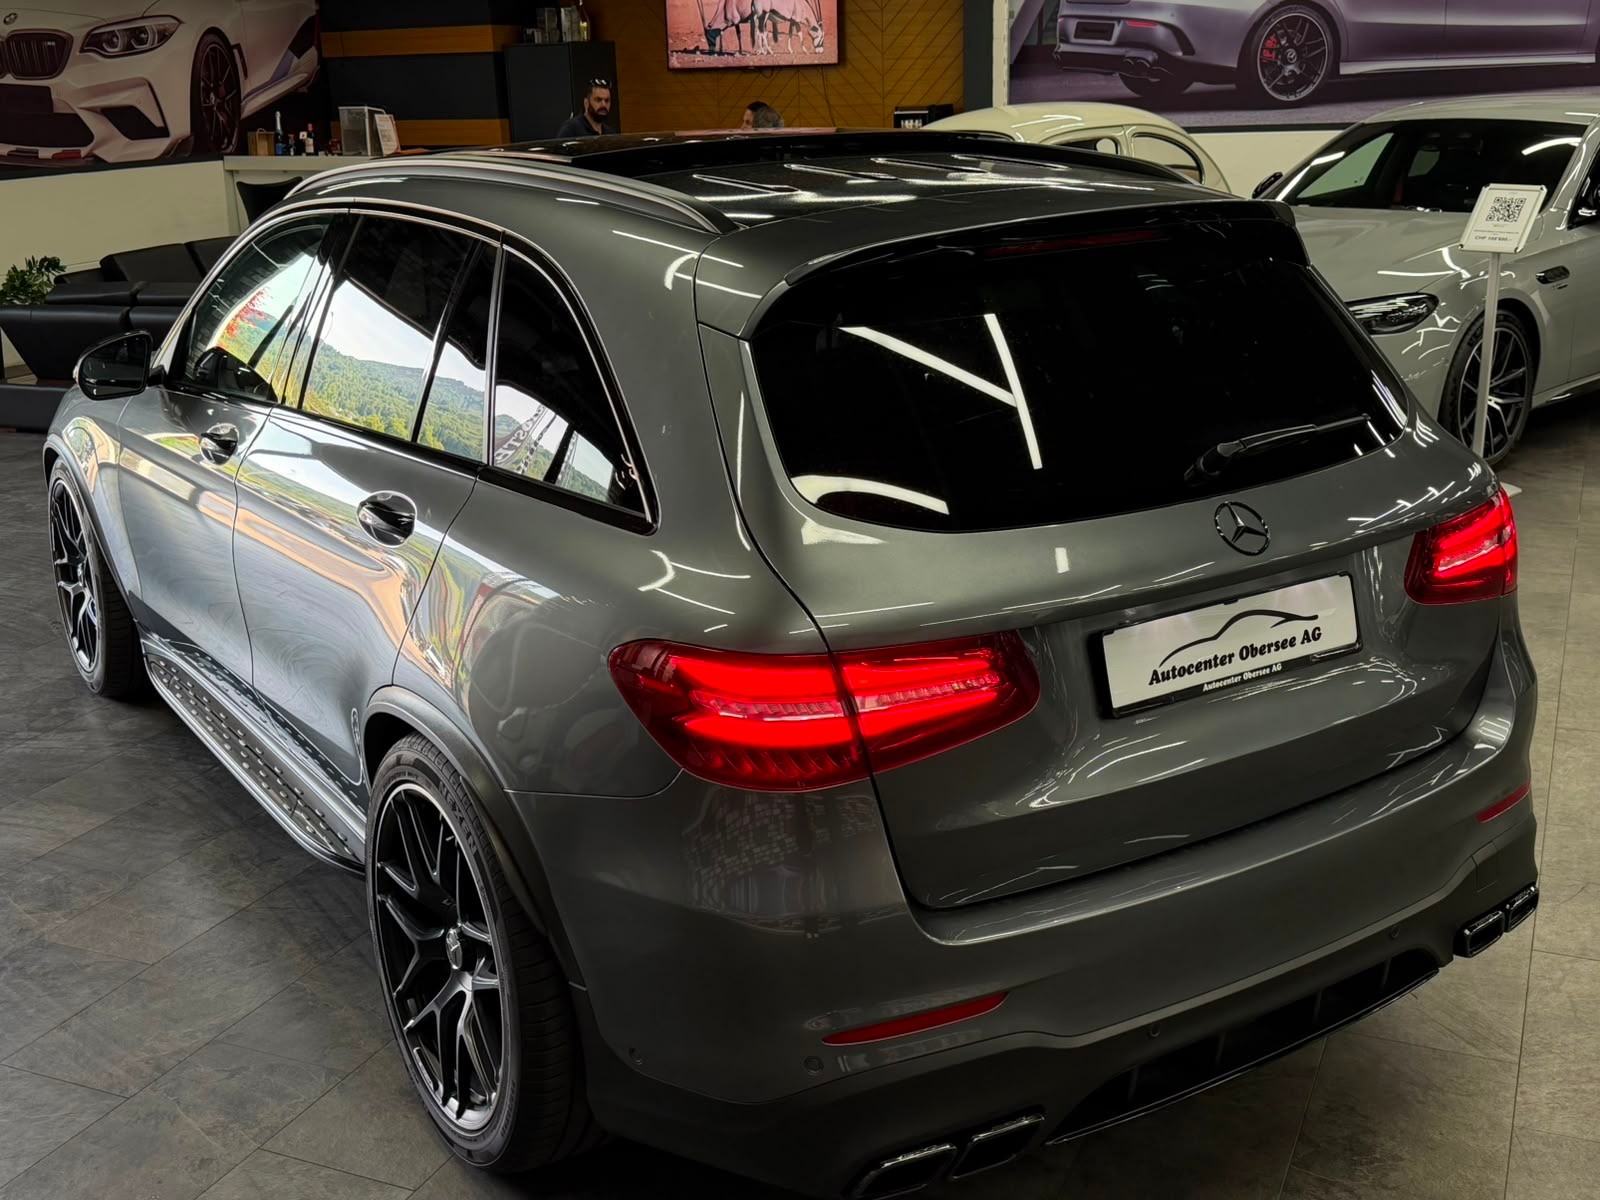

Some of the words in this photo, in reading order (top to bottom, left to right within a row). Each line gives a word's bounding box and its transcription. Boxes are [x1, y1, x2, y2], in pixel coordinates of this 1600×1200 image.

[1148, 651, 1235, 686] Autocenter
[1238, 635, 1297, 661] Obersee
[1300, 626, 1322, 645] AG
[1202, 676, 1242, 692] Autocenter
[1242, 667, 1271, 680] Obersee
[1271, 663, 1283, 673] AG
[439, 780, 478, 856] NEXEN
